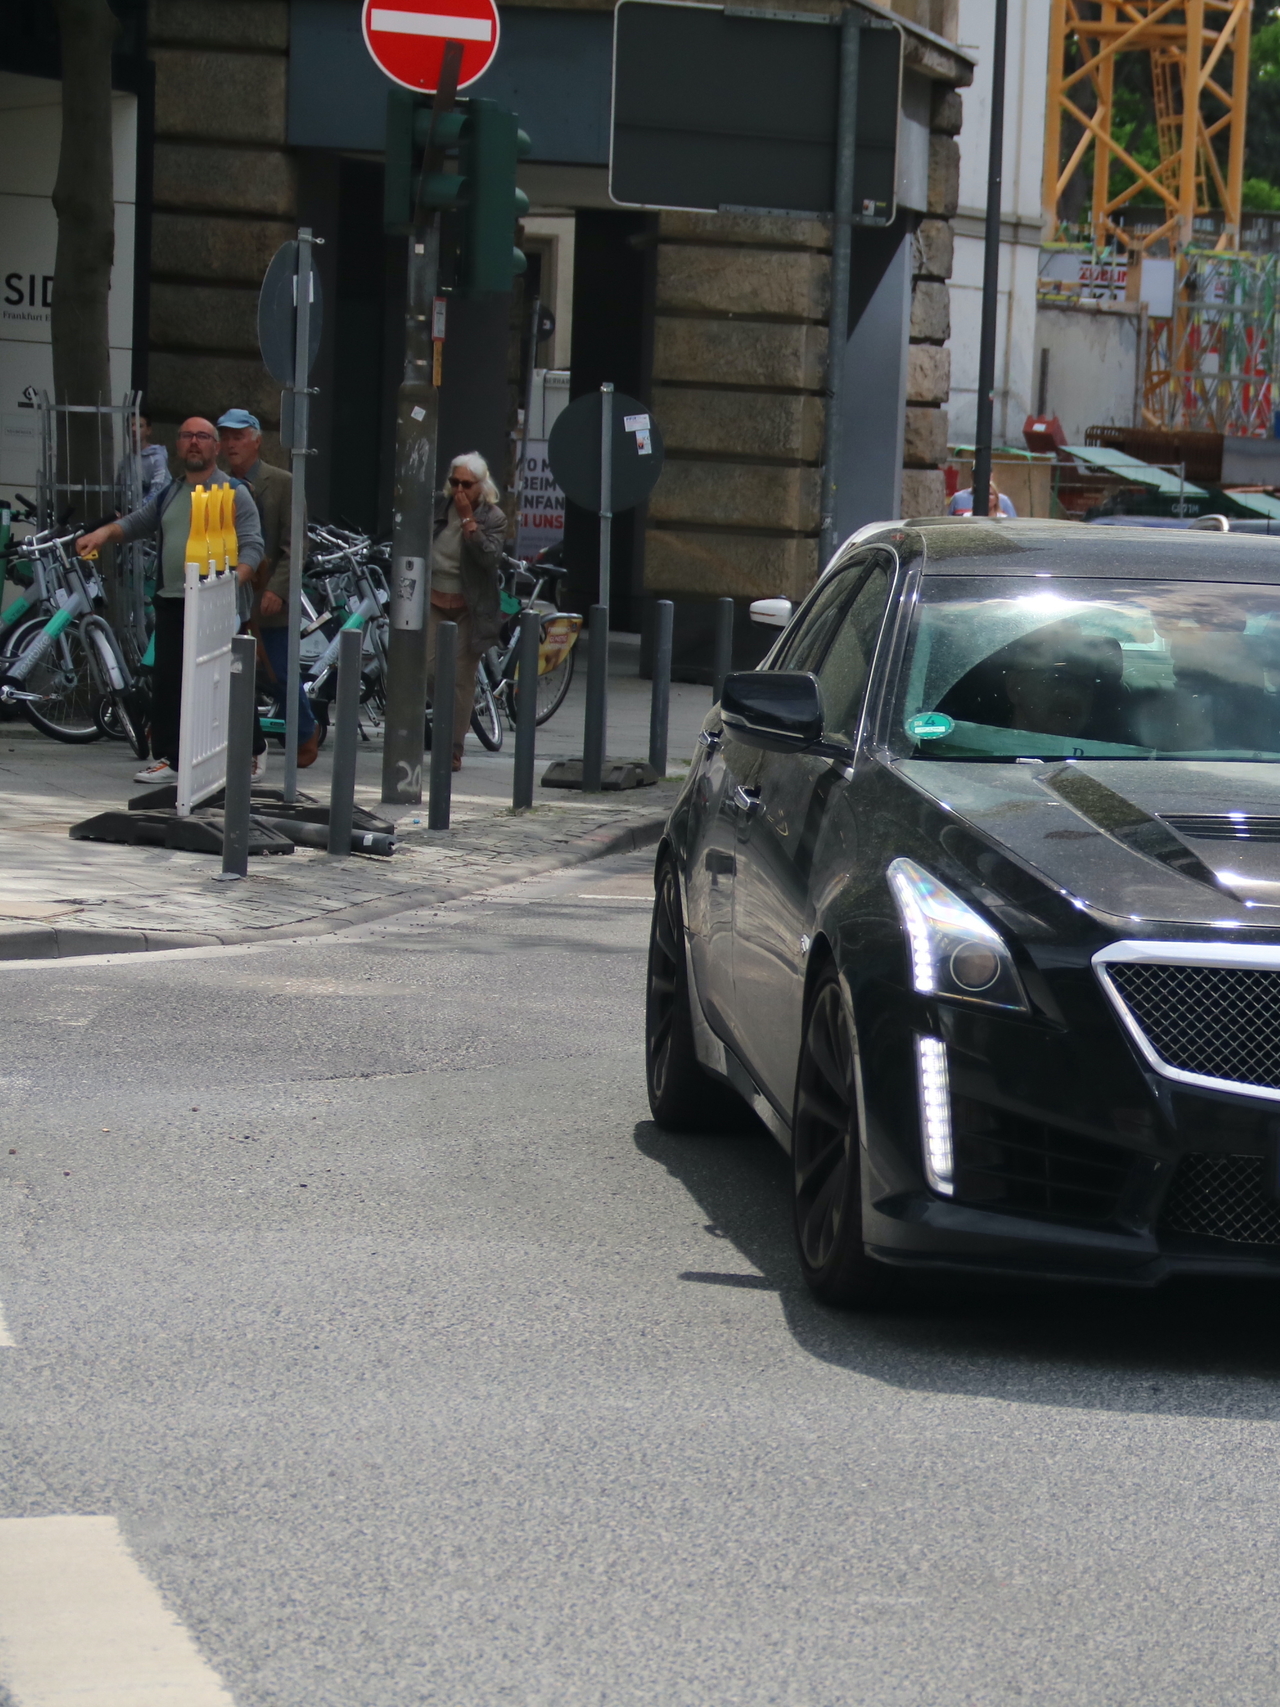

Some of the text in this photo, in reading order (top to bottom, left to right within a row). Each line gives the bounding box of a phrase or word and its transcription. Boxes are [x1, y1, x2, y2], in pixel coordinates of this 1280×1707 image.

[3, 311, 42, 321] Frankfurt
[533, 514, 564, 529] UNS
[924, 715, 936, 726] 4
